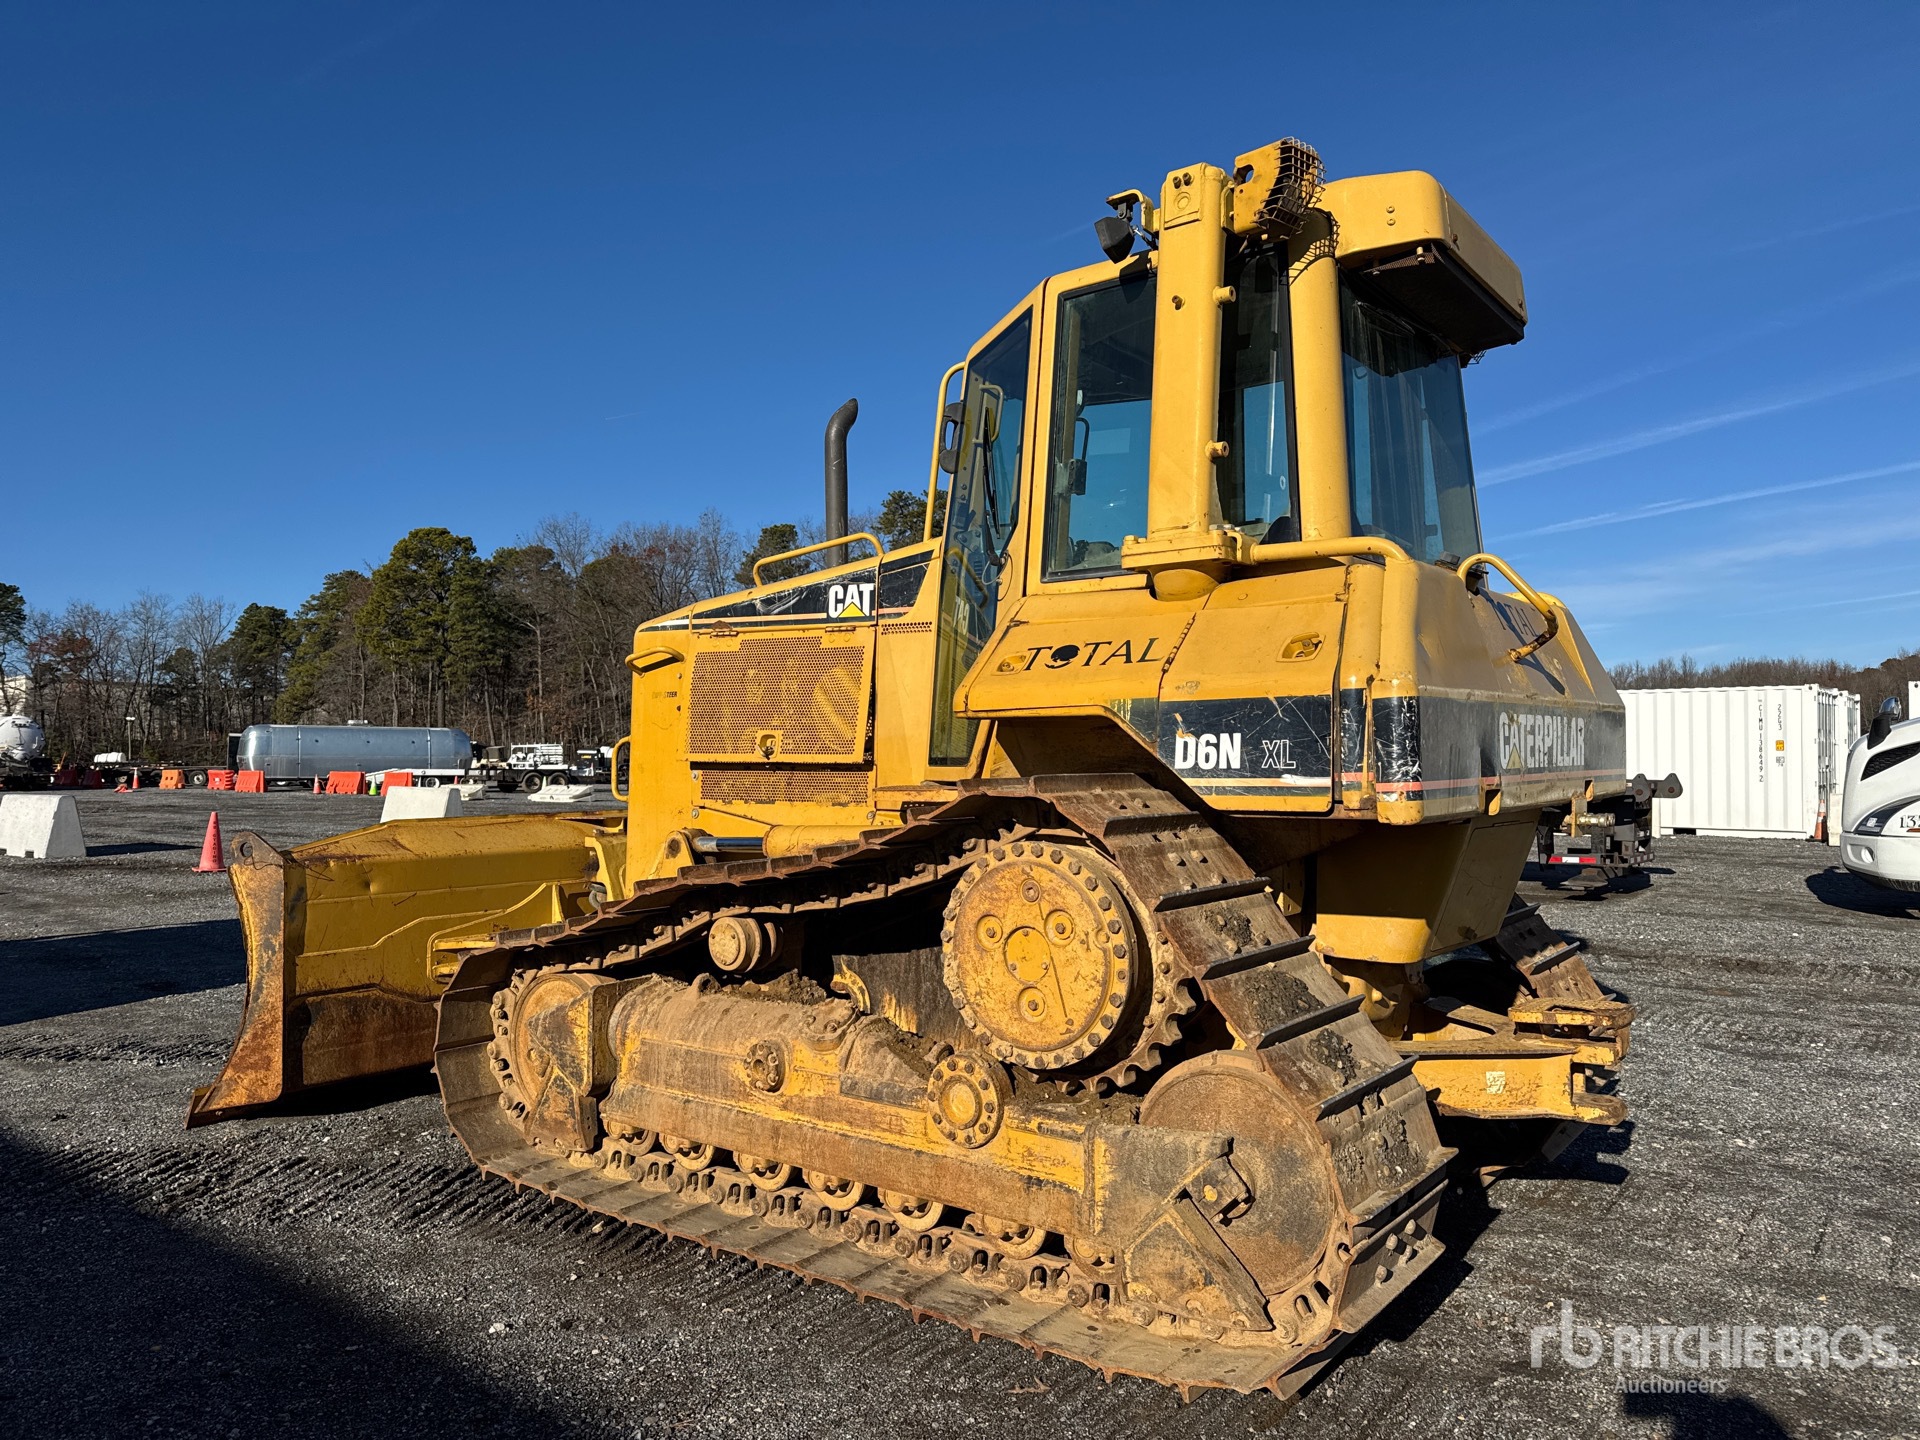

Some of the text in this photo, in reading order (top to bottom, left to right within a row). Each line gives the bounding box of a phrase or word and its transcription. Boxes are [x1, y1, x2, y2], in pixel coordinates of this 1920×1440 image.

[828, 583, 874, 618] CAT
[1023, 637, 1165, 671] TOTAL
[1174, 732, 1297, 770] D6N XL
[1499, 711, 1585, 769] CATERPILLAR
